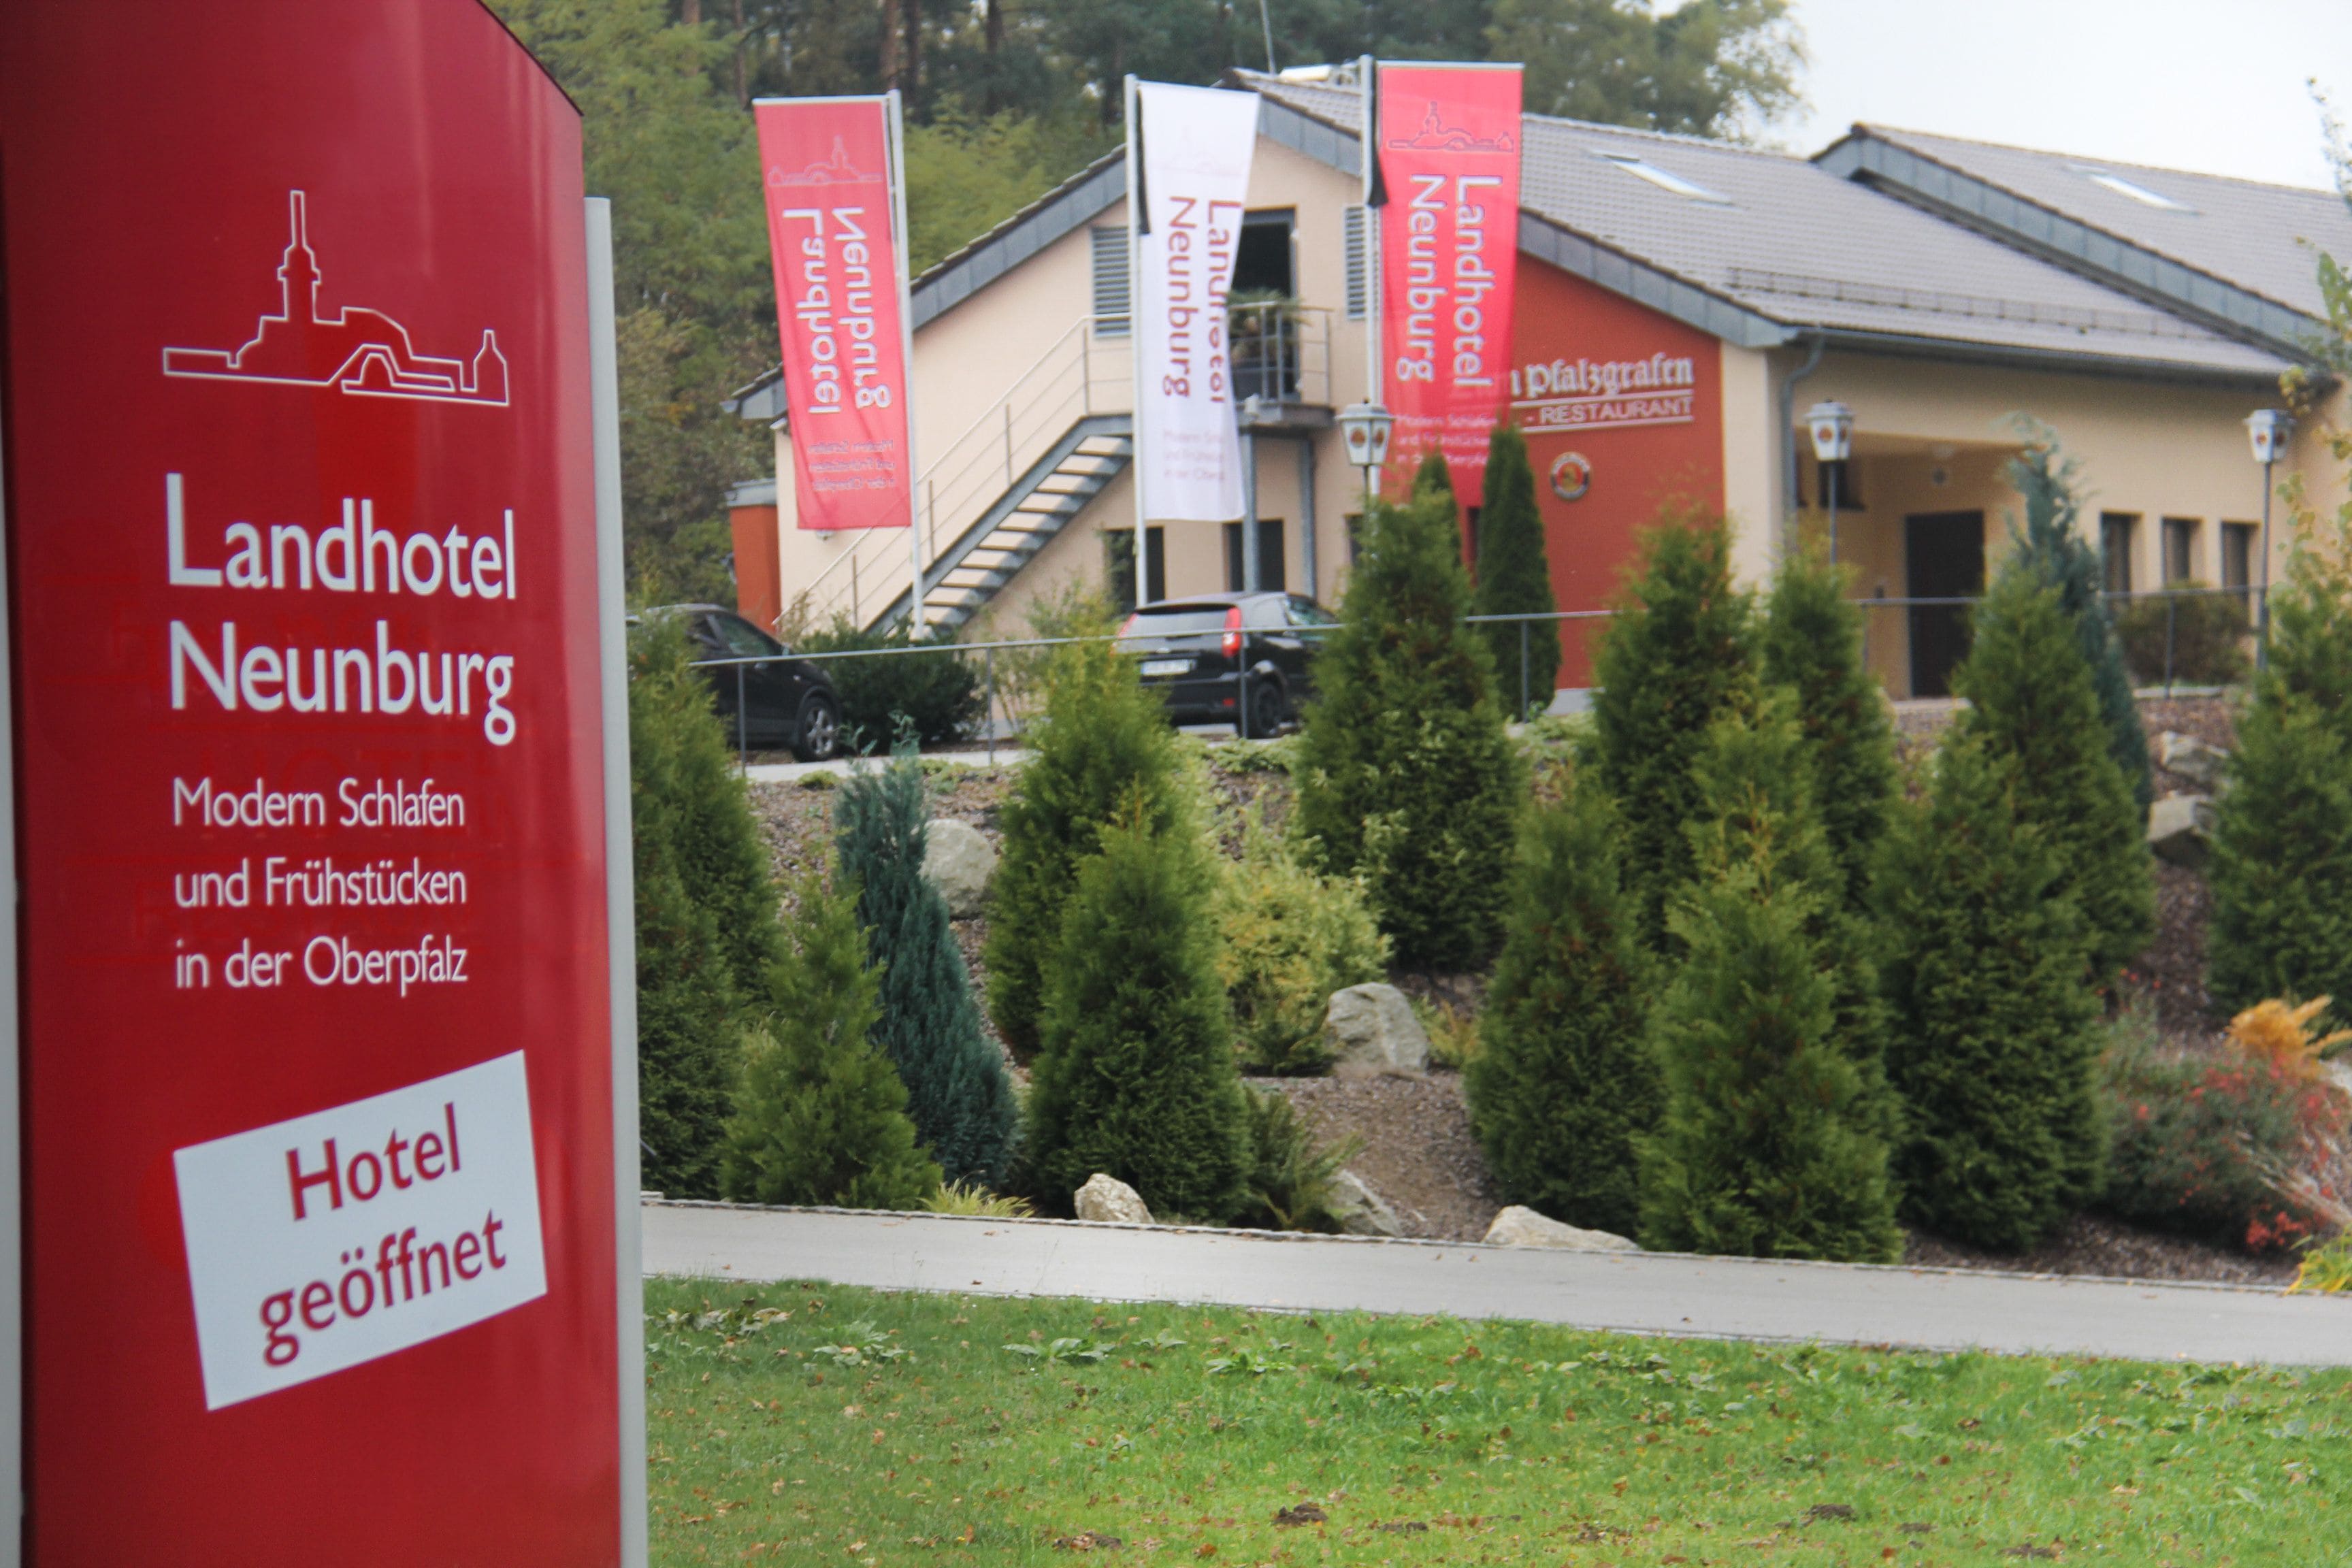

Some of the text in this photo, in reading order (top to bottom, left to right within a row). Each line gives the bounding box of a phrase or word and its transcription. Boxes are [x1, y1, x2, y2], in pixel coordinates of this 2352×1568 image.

[1163, 196, 1199, 397] Neunburg
[1396, 174, 1448, 382] Neunburg
[1453, 174, 1503, 386] Landhotel
[1524, 352, 1694, 398] Pfalzgrafen
[1539, 396, 1693, 425] RESTAURANT
[166, 473, 516, 600] Landhotel
[170, 620, 516, 746] Neunburg
[174, 777, 466, 827] Modern Schlafen
[174, 857, 467, 908] und Frühstücken
[176, 934, 468, 998] in der Oberpfalz
[285, 1101, 461, 1222] Hotel
[259, 1209, 507, 1368] geöffnet
